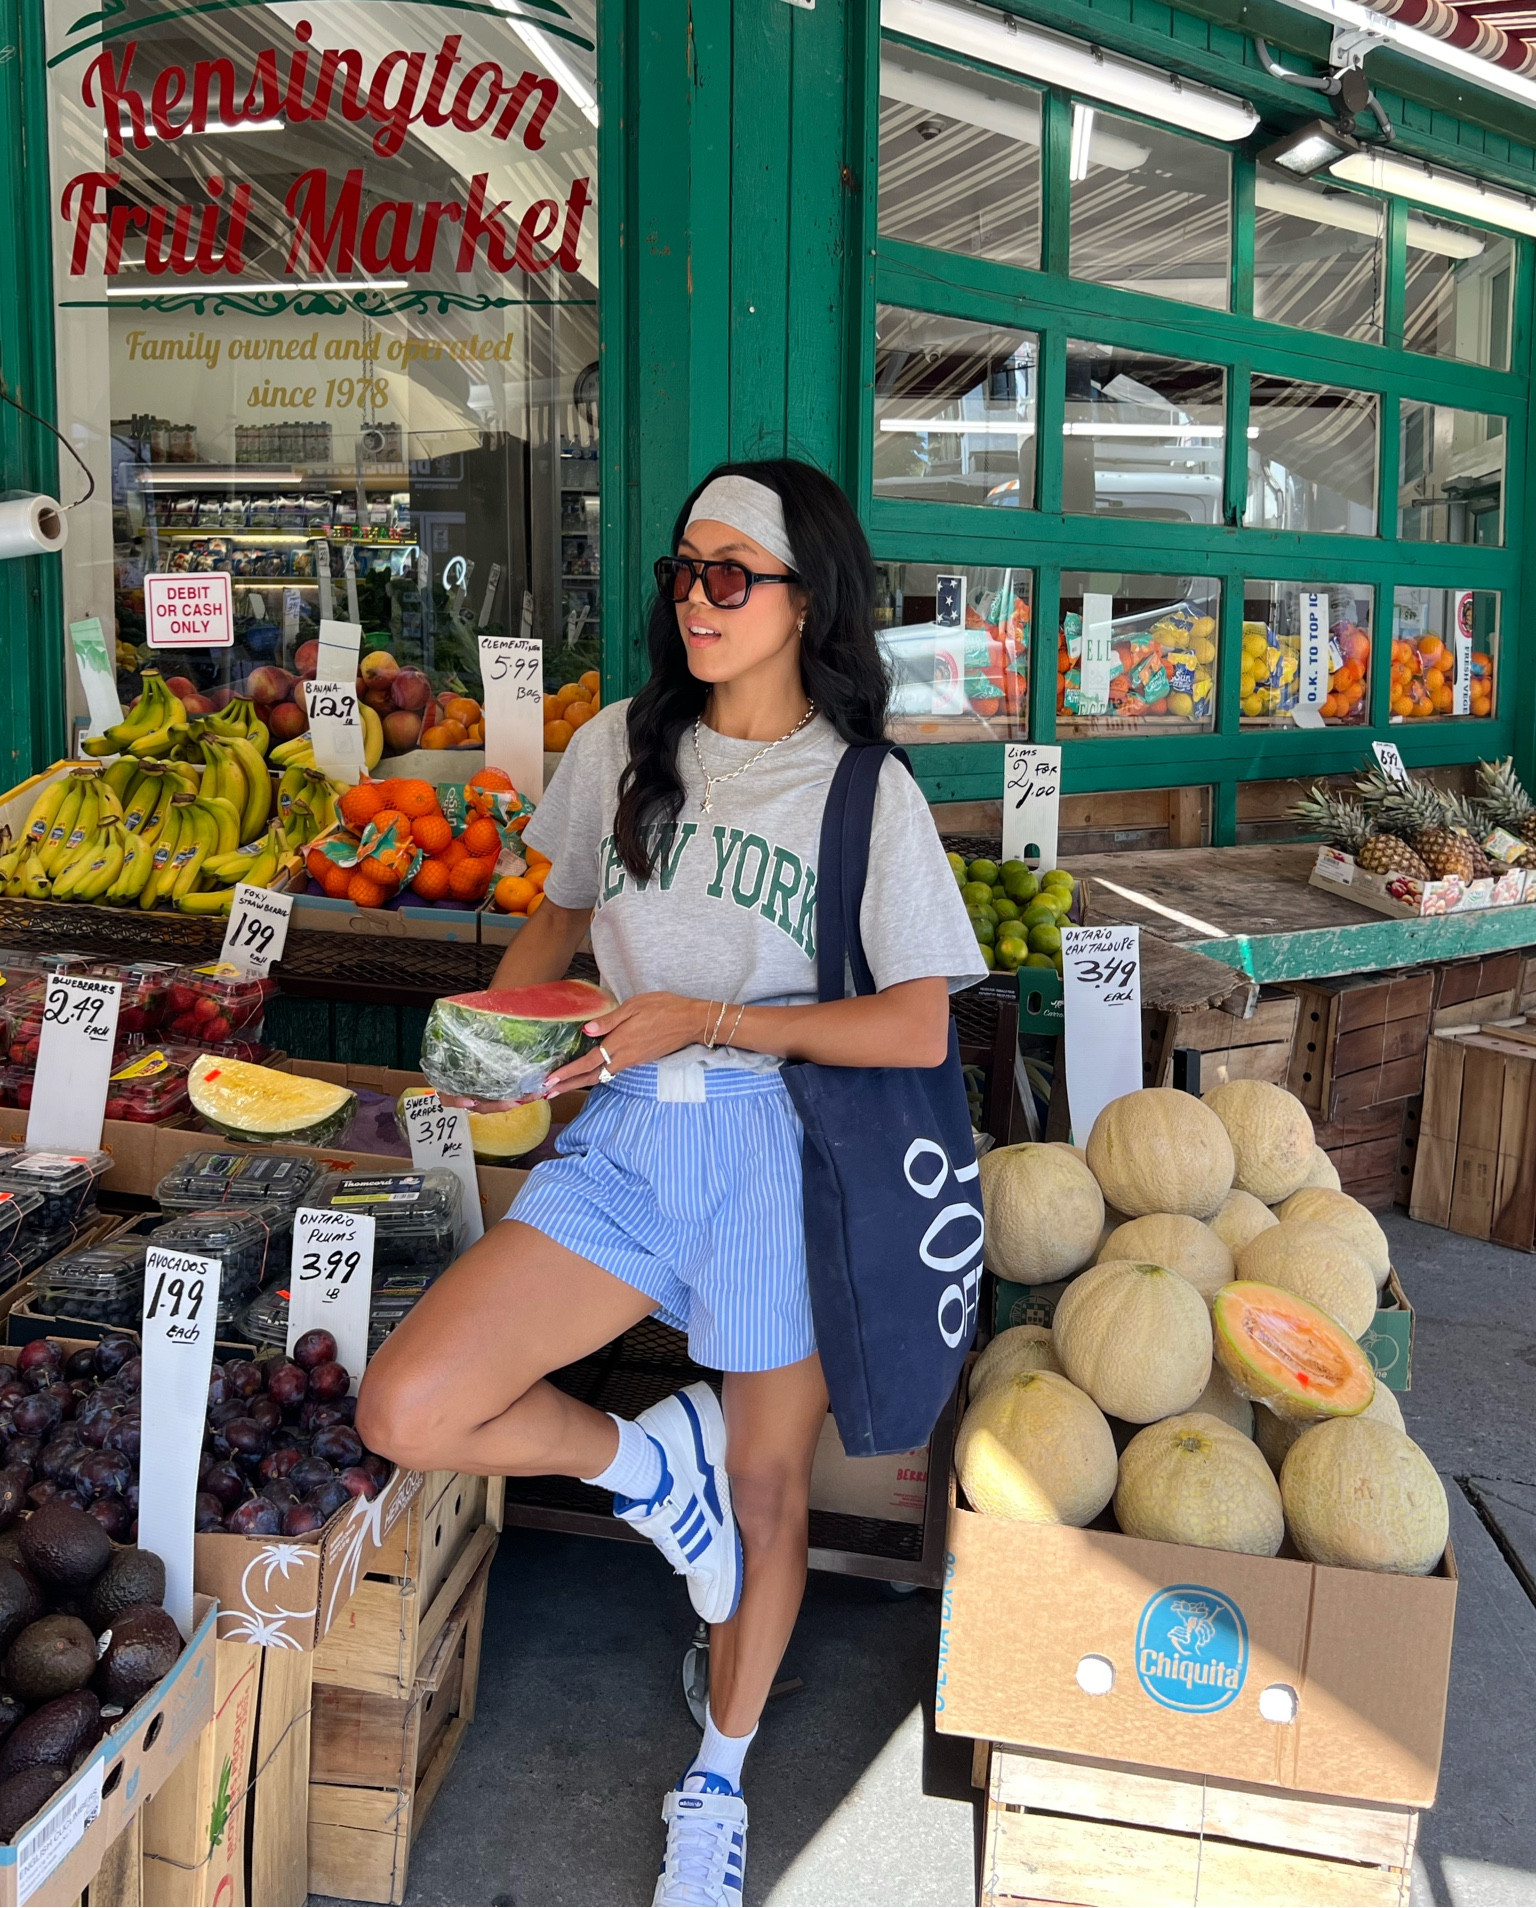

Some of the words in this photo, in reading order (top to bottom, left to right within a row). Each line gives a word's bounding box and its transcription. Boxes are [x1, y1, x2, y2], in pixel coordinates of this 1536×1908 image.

[81, 20, 560, 158] Kensington
[60, 171, 253, 276] Fruit
[284, 168, 593, 275] Market
[125, 330, 220, 372] Family
[227, 332, 319, 362] owned
[324, 331, 383, 361] and
[387, 332, 514, 370] operated
[247, 378, 318, 408] since
[326, 377, 390, 409] 1978
[167, 586, 210, 600] DEBIT
[156, 604, 177, 617] OR
[182, 603, 223, 616] CASH
[170, 620, 210, 634] ONLY
[1309, 613, 1319, 644] TOP
[490, 655, 539, 681] 5.99
[1309, 646, 1319, 665] TO
[305, 682, 341, 694] BANANA
[1307, 671, 1318, 702] O.K.
[310, 695, 355, 719] 1.29
[1007, 758, 1029, 789] 2
[1035, 763, 1058, 776] FOR
[599, 822, 699, 910] EW
[244, 888, 268, 902] FOXY
[1065, 938, 1136, 956] CANTALOUPE
[52, 976, 116, 995] BLUEBERRIES
[1074, 957, 1137, 988] 3.49
[43, 989, 105, 1025] 2.49
[405, 1095, 436, 1110] SWEET
[410, 1104, 444, 1120] GRAPES
[416, 1115, 458, 1145] 3.99
[343, 1178, 394, 1188] Thomcord
[307, 1228, 357, 1243] PLUMS
[147, 1252, 209, 1275] AVOCADOS
[299, 1250, 361, 1284] 3.99
[145, 1272, 205, 1320] 1.99
[1140, 1648, 1239, 1690] Chiquita
[18, 1838, 53, 1880] ENGLISH
